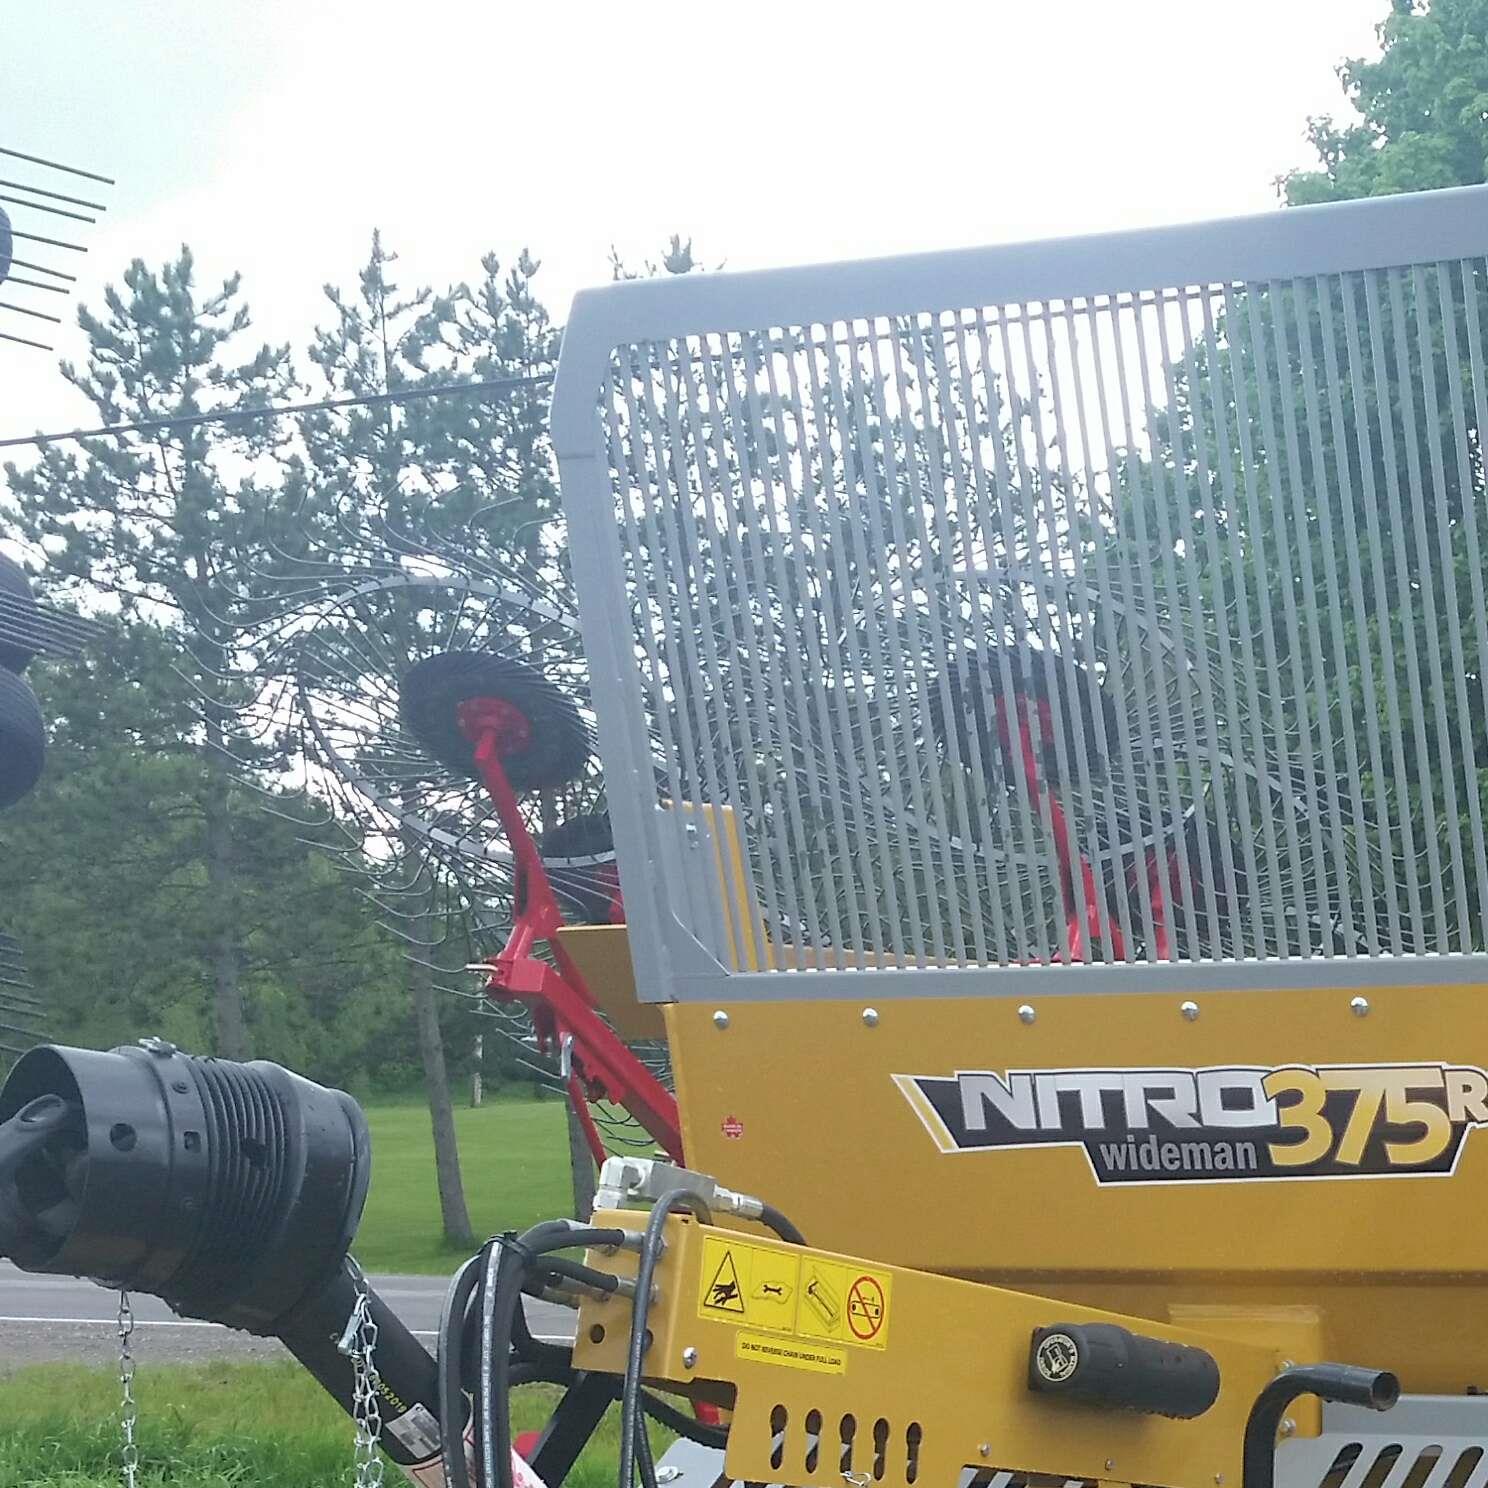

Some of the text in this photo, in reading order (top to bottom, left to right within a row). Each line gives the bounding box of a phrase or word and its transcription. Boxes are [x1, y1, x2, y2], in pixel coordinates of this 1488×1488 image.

[958, 1070, 1278, 1131] NITRO
[1262, 1066, 1452, 1166] 375
[1100, 1134, 1258, 1171] wideman
